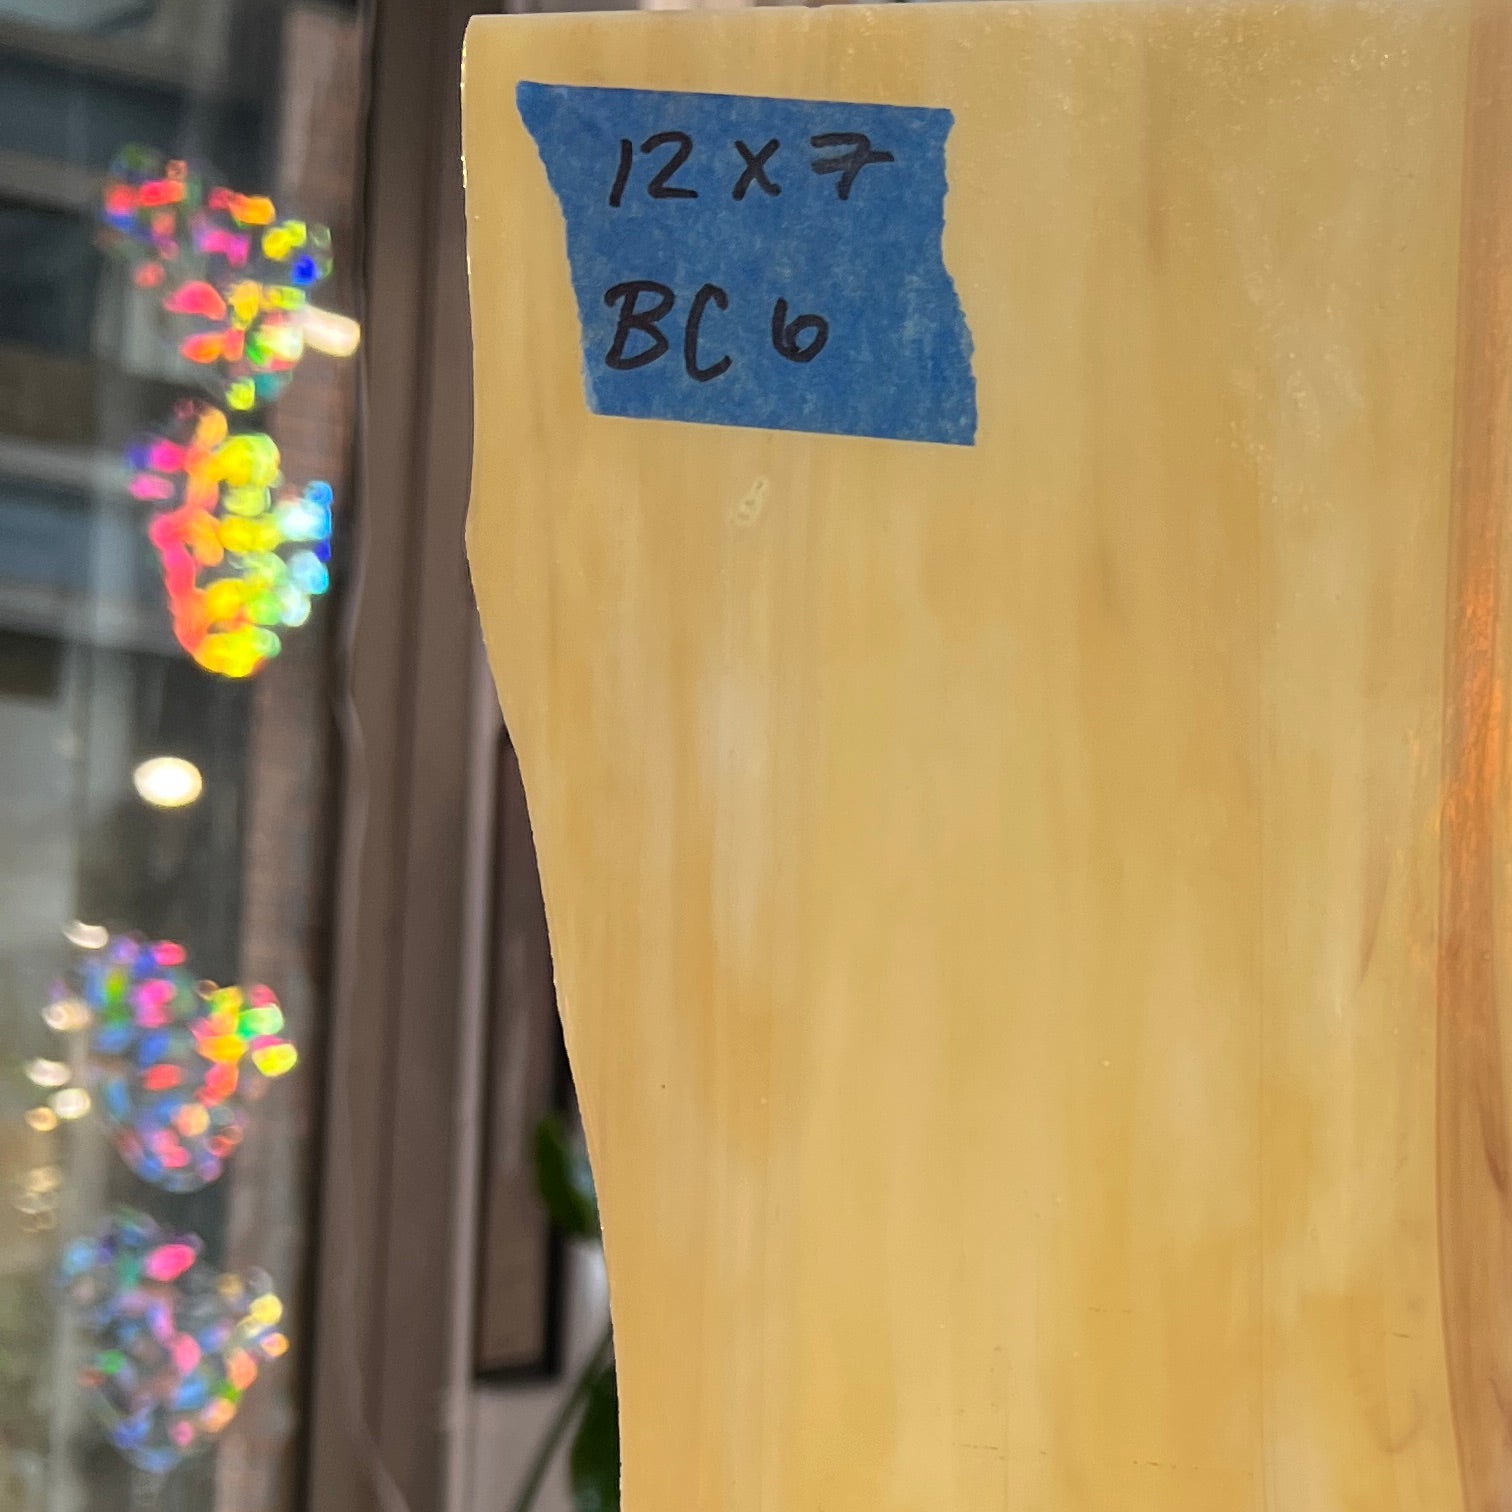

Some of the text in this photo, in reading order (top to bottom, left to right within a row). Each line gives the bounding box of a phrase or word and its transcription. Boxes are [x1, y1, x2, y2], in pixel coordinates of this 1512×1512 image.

[609, 131, 698, 207] 12
[811, 132, 894, 200] 7
[604, 280, 828, 382] BC 6
